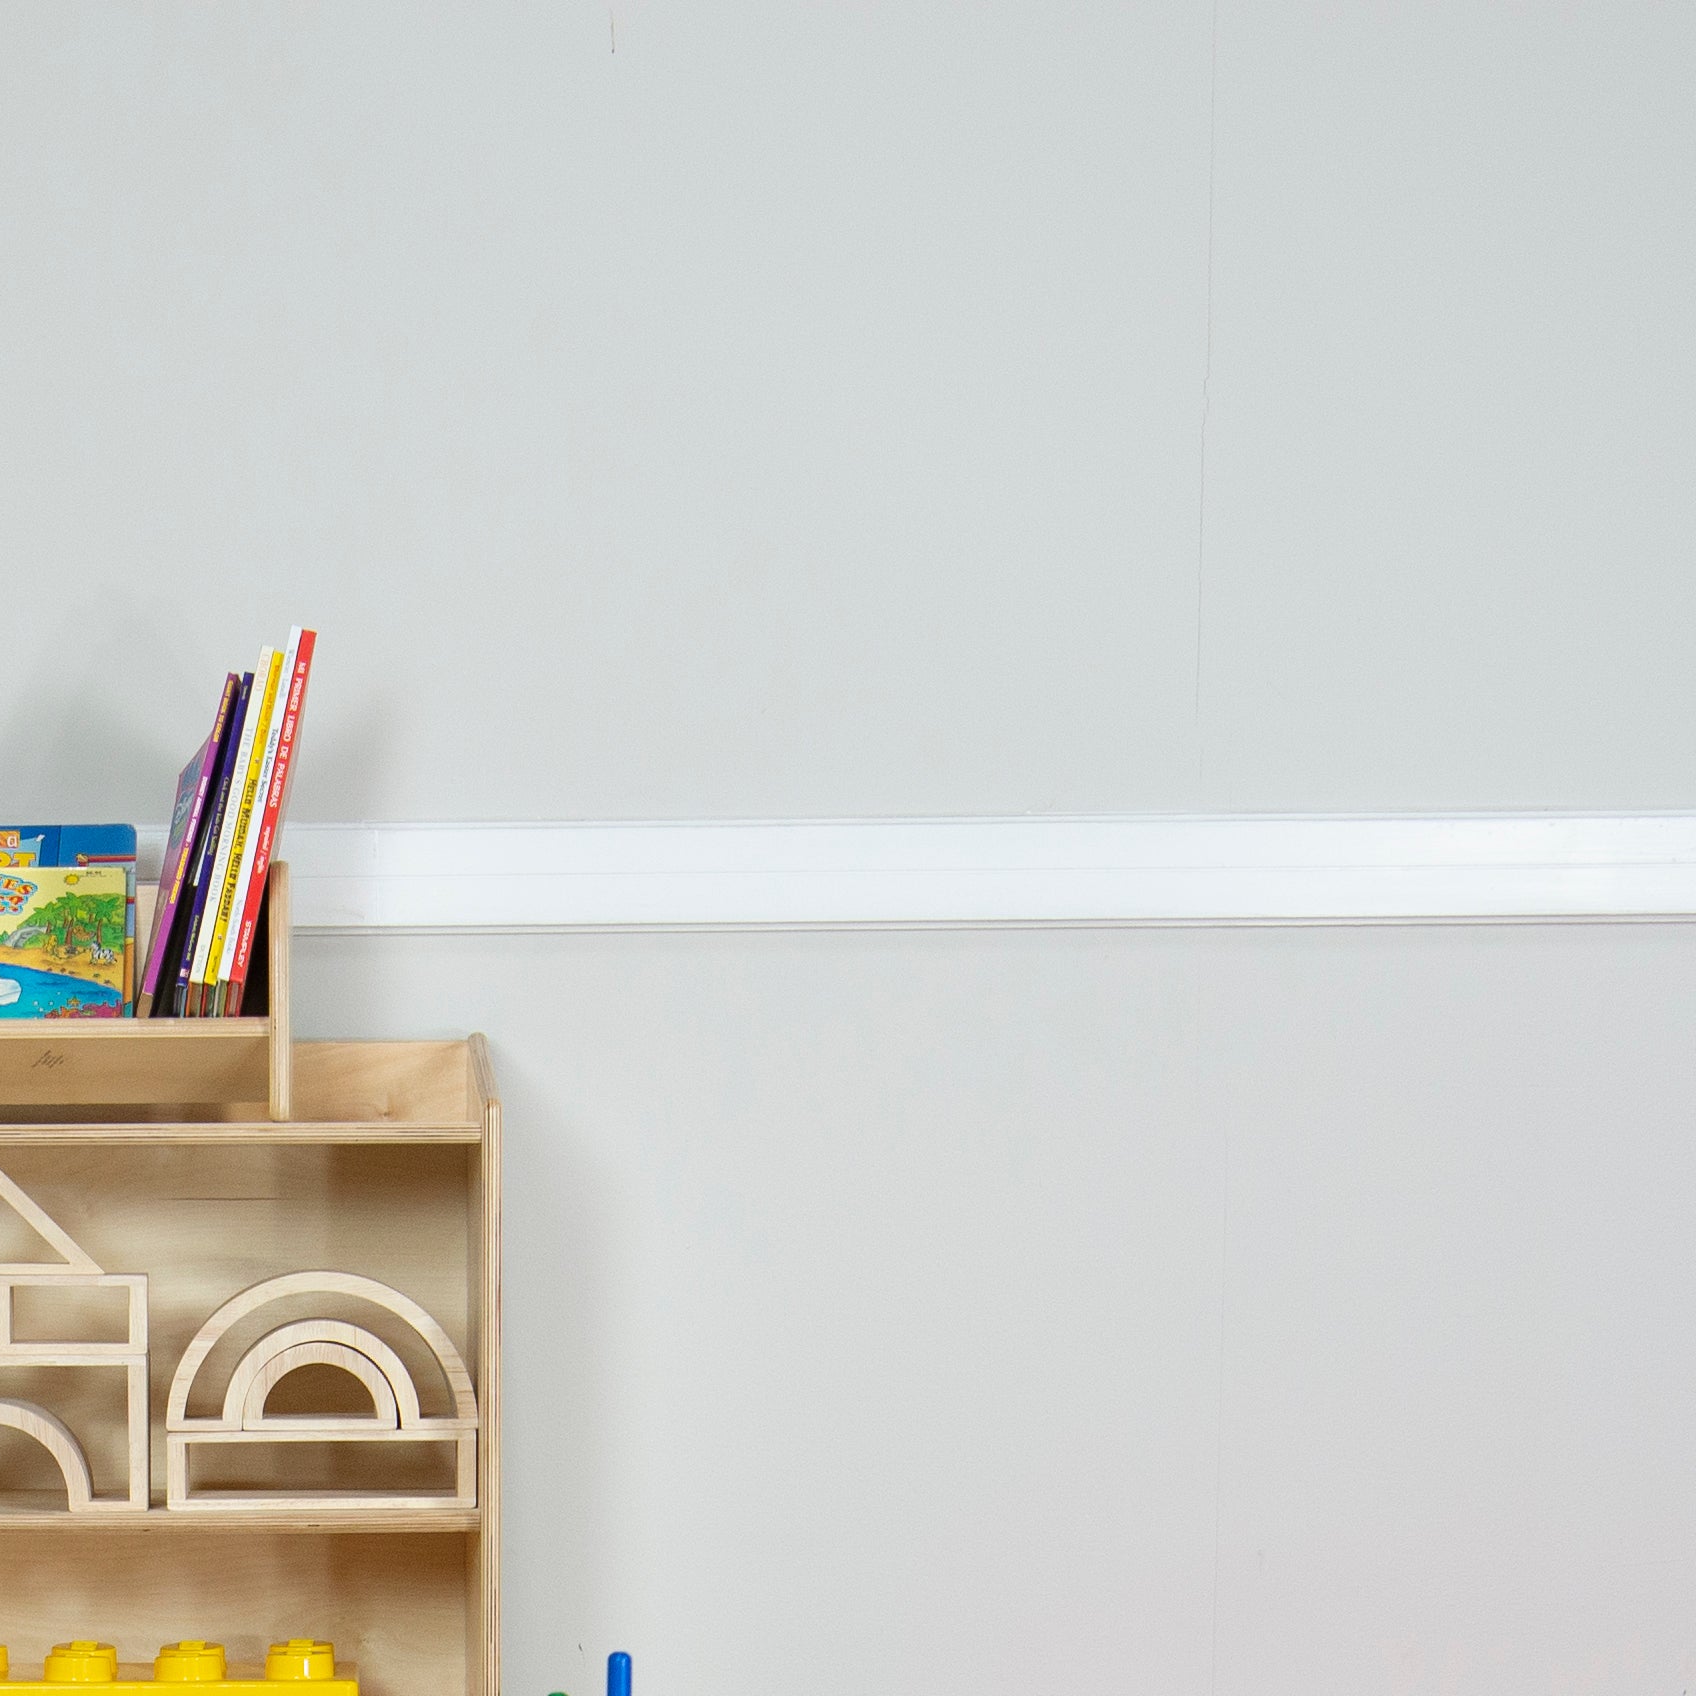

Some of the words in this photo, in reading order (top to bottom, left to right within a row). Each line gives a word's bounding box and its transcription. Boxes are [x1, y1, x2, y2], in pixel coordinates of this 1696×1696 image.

[297, 661, 306, 673] MI
[289, 677, 302, 711] PRIMER
[242, 726, 253, 748] THE
[266, 727, 278, 754] Teddy's
[283, 714, 295, 742] LIBRO
[279, 745, 288, 759] DE
[269, 762, 285, 808] PALABRAS
[227, 787, 240, 818] GOOD
[7, 833, 17, 848] a
[216, 820, 233, 871] MORNING
[208, 873, 221, 902] BOOK
